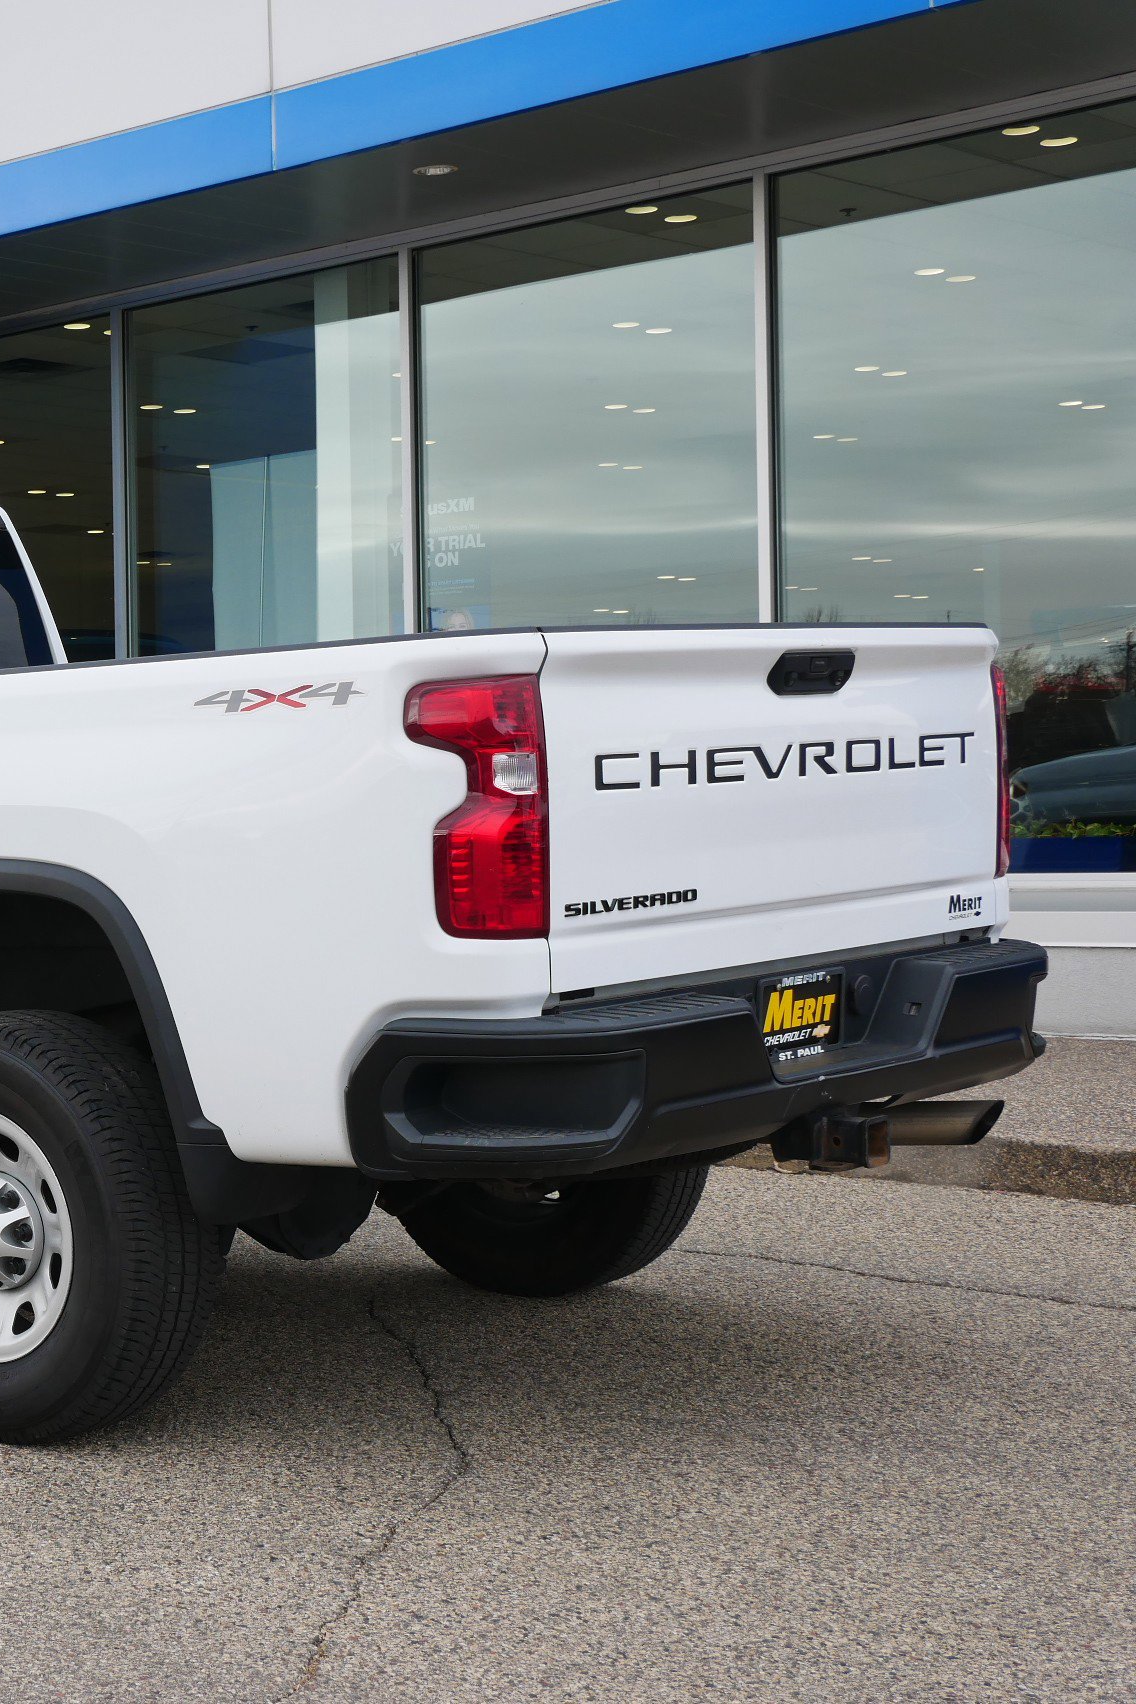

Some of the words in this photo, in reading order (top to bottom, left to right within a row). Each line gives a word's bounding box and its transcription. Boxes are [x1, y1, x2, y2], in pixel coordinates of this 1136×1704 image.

[437, 533, 486, 551] TRIAL
[434, 551, 459, 568] ON
[594, 732, 975, 791] CHEVROLET
[564, 888, 698, 918] SILVERADO
[948, 894, 982, 914] MERIT
[781, 971, 826, 987] MERIT
[763, 989, 836, 1034] MERIT
[764, 1028, 812, 1047] CHEVROLET
[778, 1051, 795, 1061] ST.
[797, 1045, 825, 1058] PAUL
